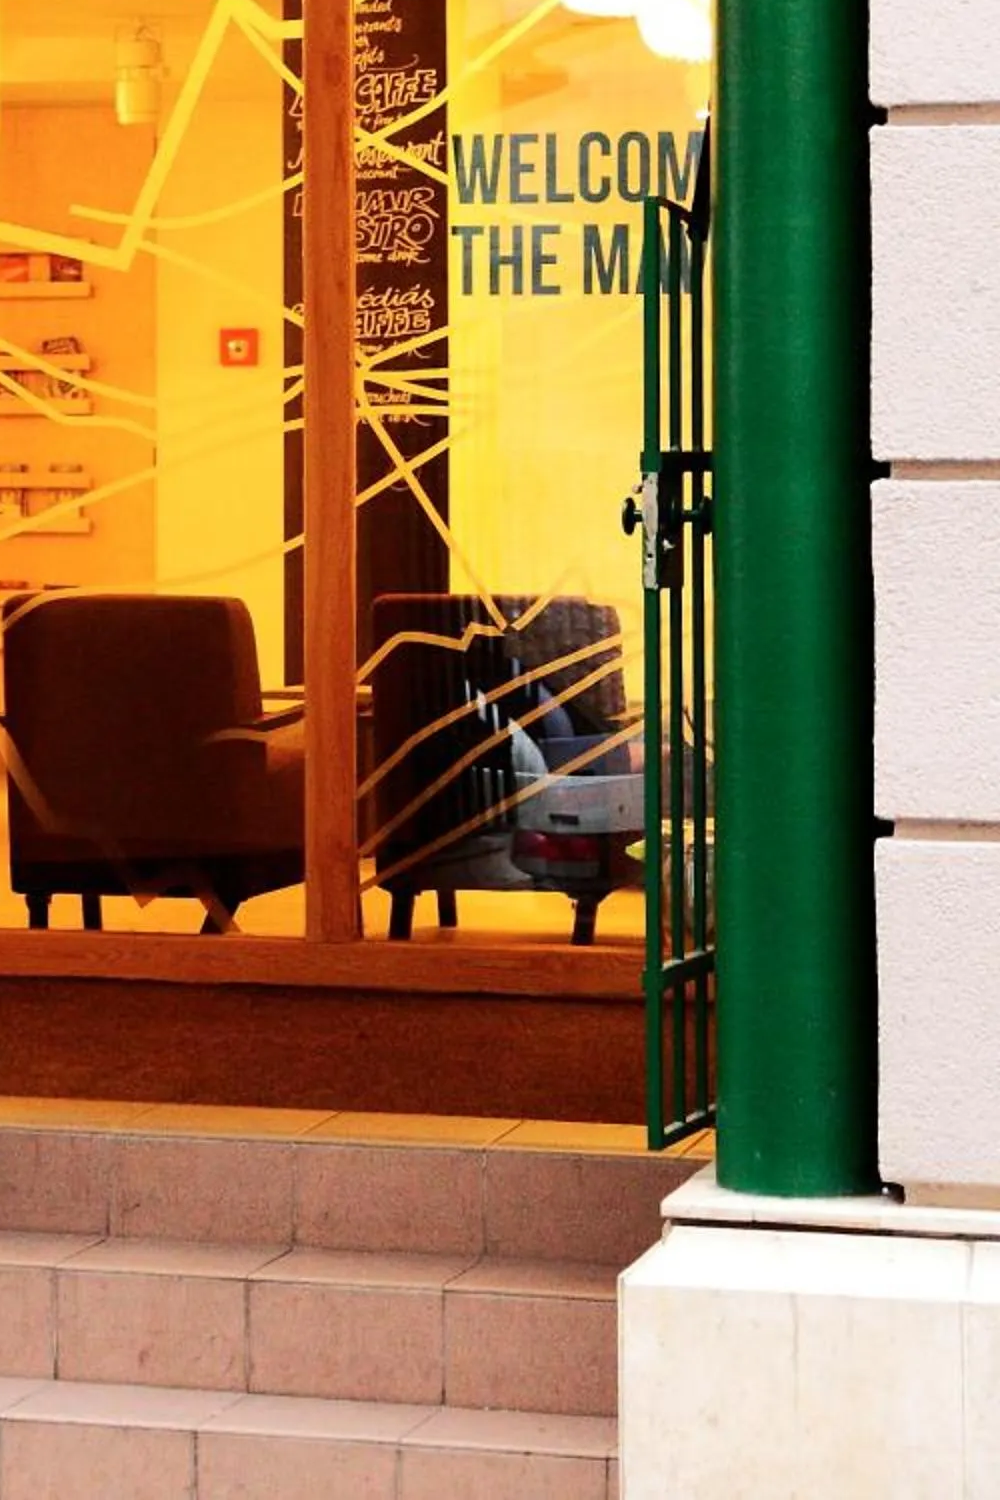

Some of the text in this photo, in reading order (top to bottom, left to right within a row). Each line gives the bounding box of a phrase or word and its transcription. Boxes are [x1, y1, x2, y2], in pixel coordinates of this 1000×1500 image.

[355, 214, 435, 251] STRO
[452, 224, 561, 296] THE
[355, 307, 431, 339] AFFE
